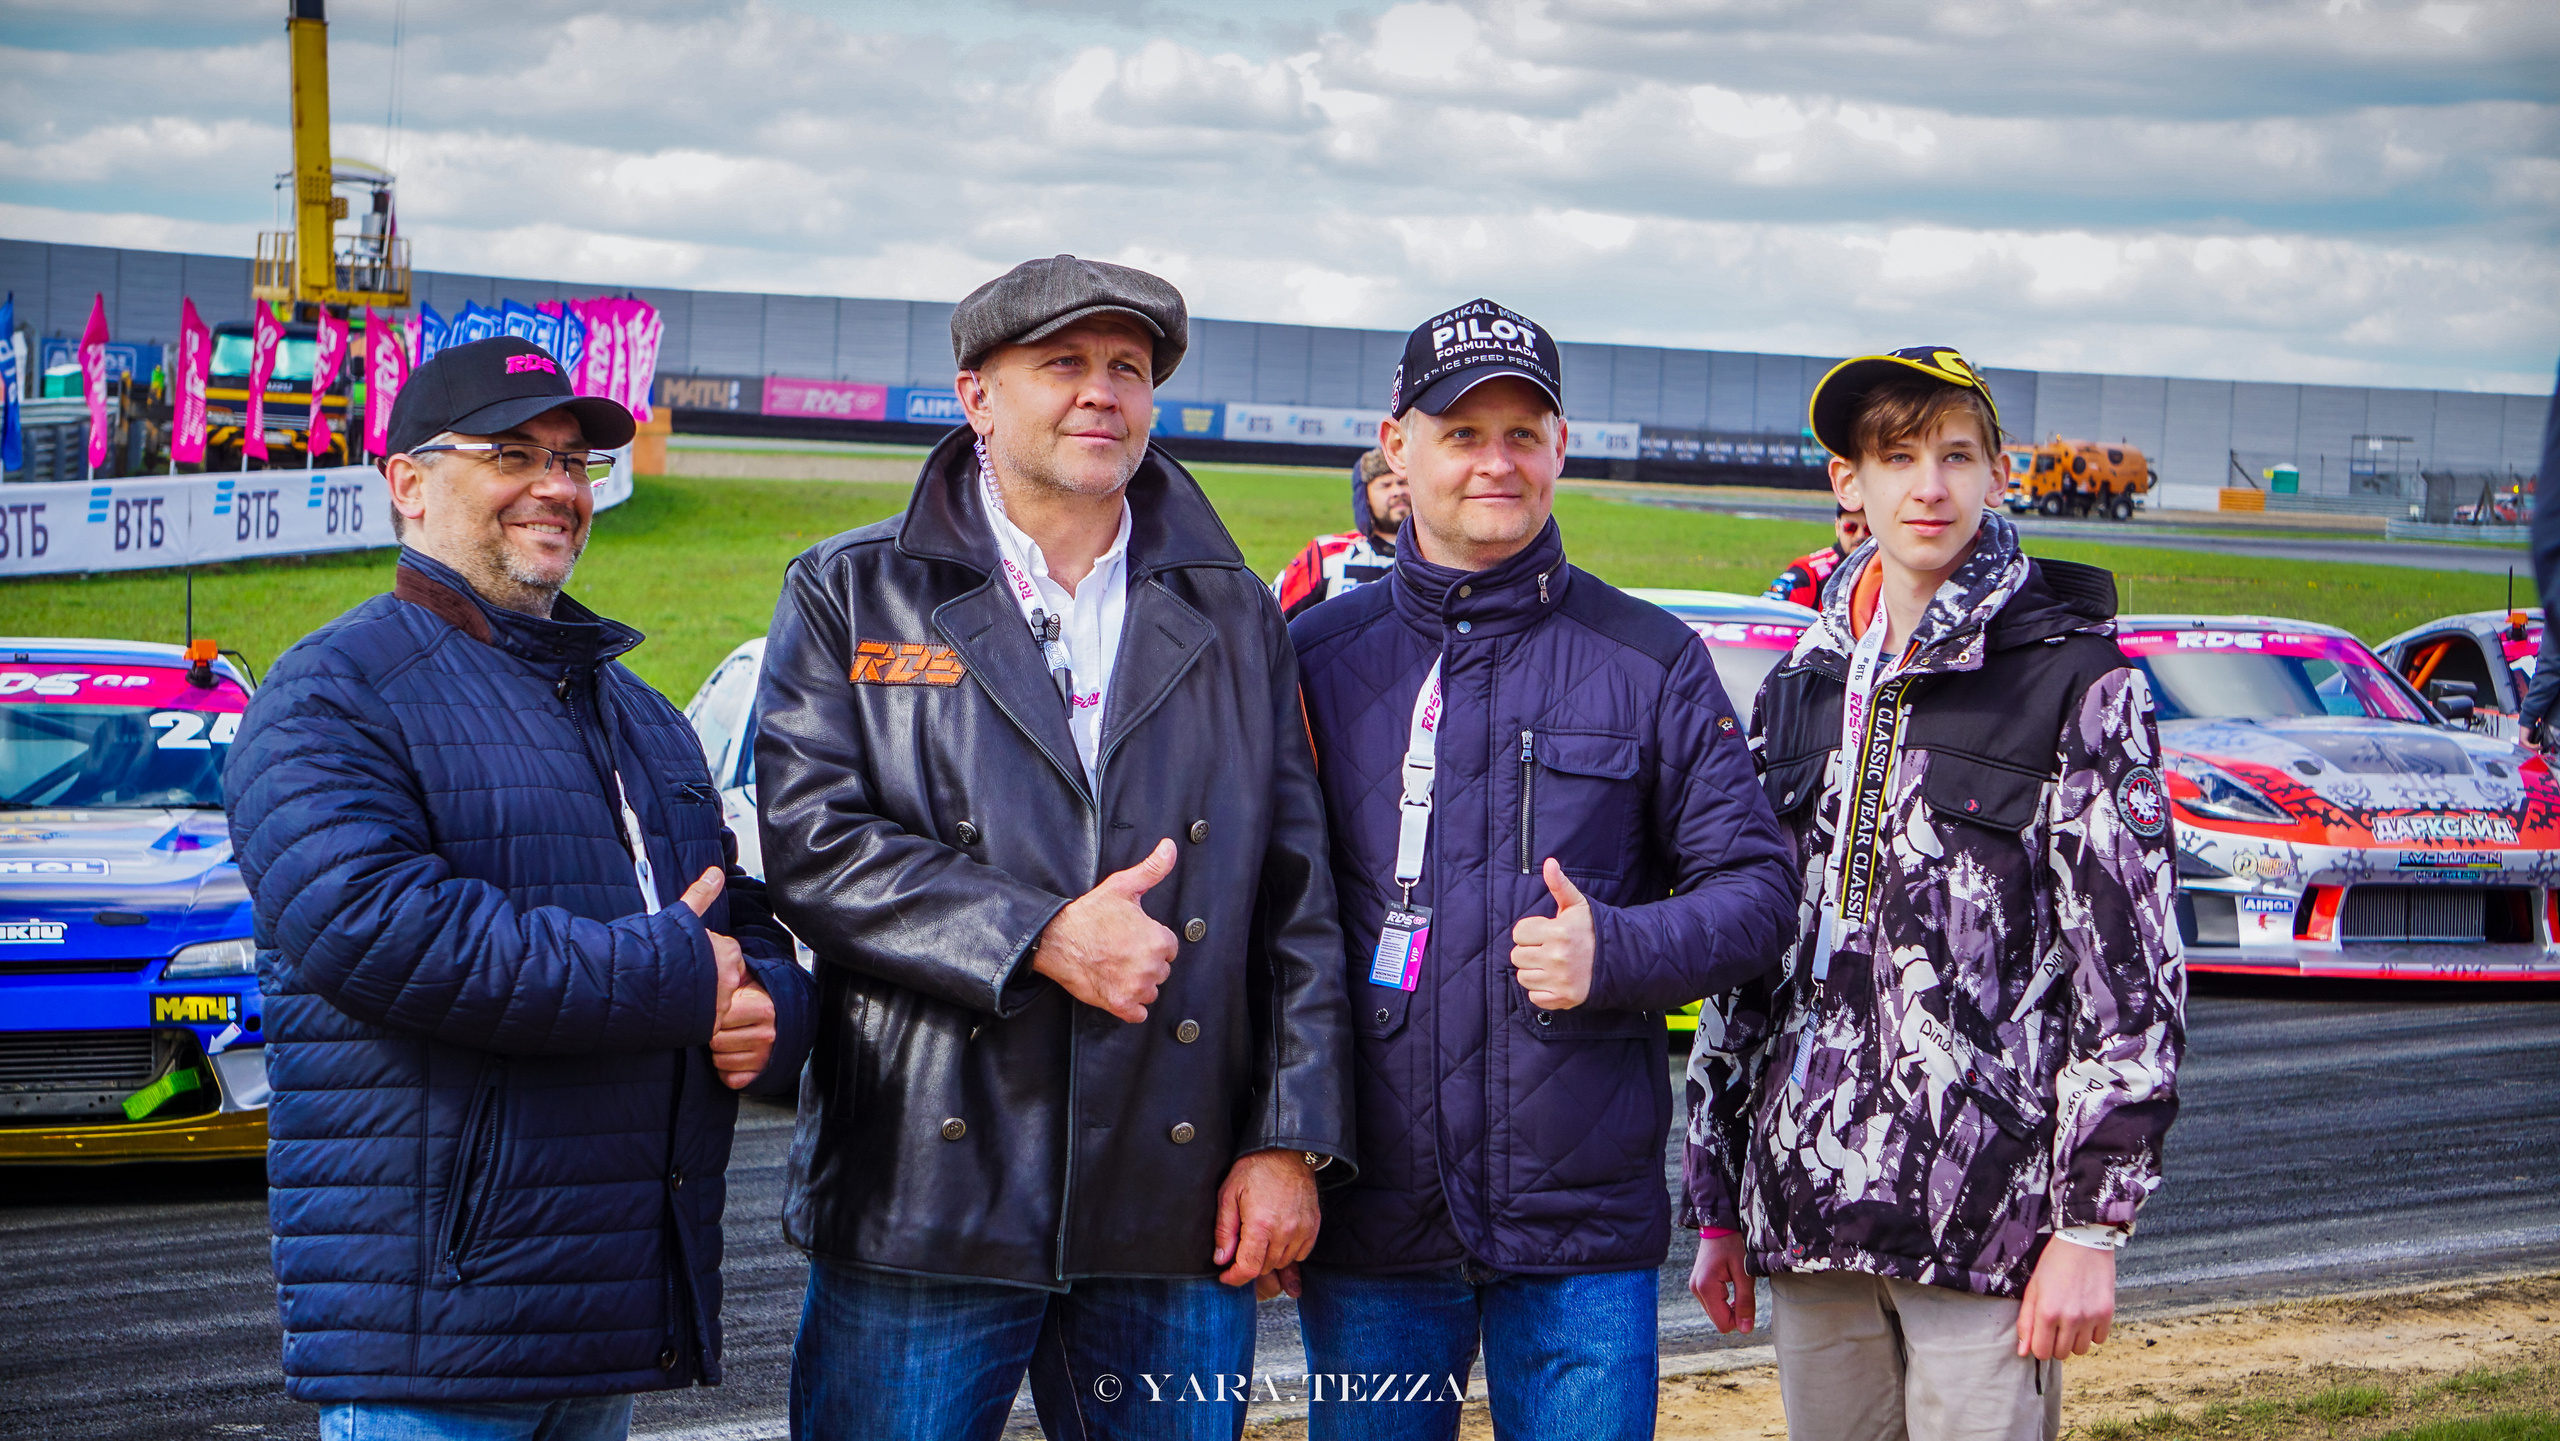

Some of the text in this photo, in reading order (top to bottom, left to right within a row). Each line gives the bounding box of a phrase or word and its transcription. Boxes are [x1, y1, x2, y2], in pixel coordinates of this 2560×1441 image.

[1432, 303, 1534, 330] BAIKAL MILE
[1432, 318, 1537, 350] PILOT
[506, 353, 556, 375] RDS
[1435, 340, 1540, 361] FORMULA LADA
[1442, 358, 1461, 372] ICE
[1464, 354, 1505, 365] SPEED
[1508, 356, 1553, 382] FESTIVAL
[802, 387, 852, 414] RDS
[114, 498, 164, 551] ВТБ
[236, 490, 279, 541] ВТБ
[326, 485, 363, 534] ВТБ
[2176, 631, 2264, 649] RDS
[848, 641, 963, 684] RDS
[1421, 692, 1440, 733] RDS
[1849, 691, 1863, 729] RDS
[1867, 708, 1895, 783] CLASSIC
[1855, 788, 1880, 846] WEAR
[2374, 812, 2520, 844] ДАРКСАЙД
[2400, 851, 2502, 865] EVOLUTION
[1386, 910, 1415, 926] RDS
[2244, 898, 2292, 911] AIMOL
[1410, 947, 1420, 962] VIP
